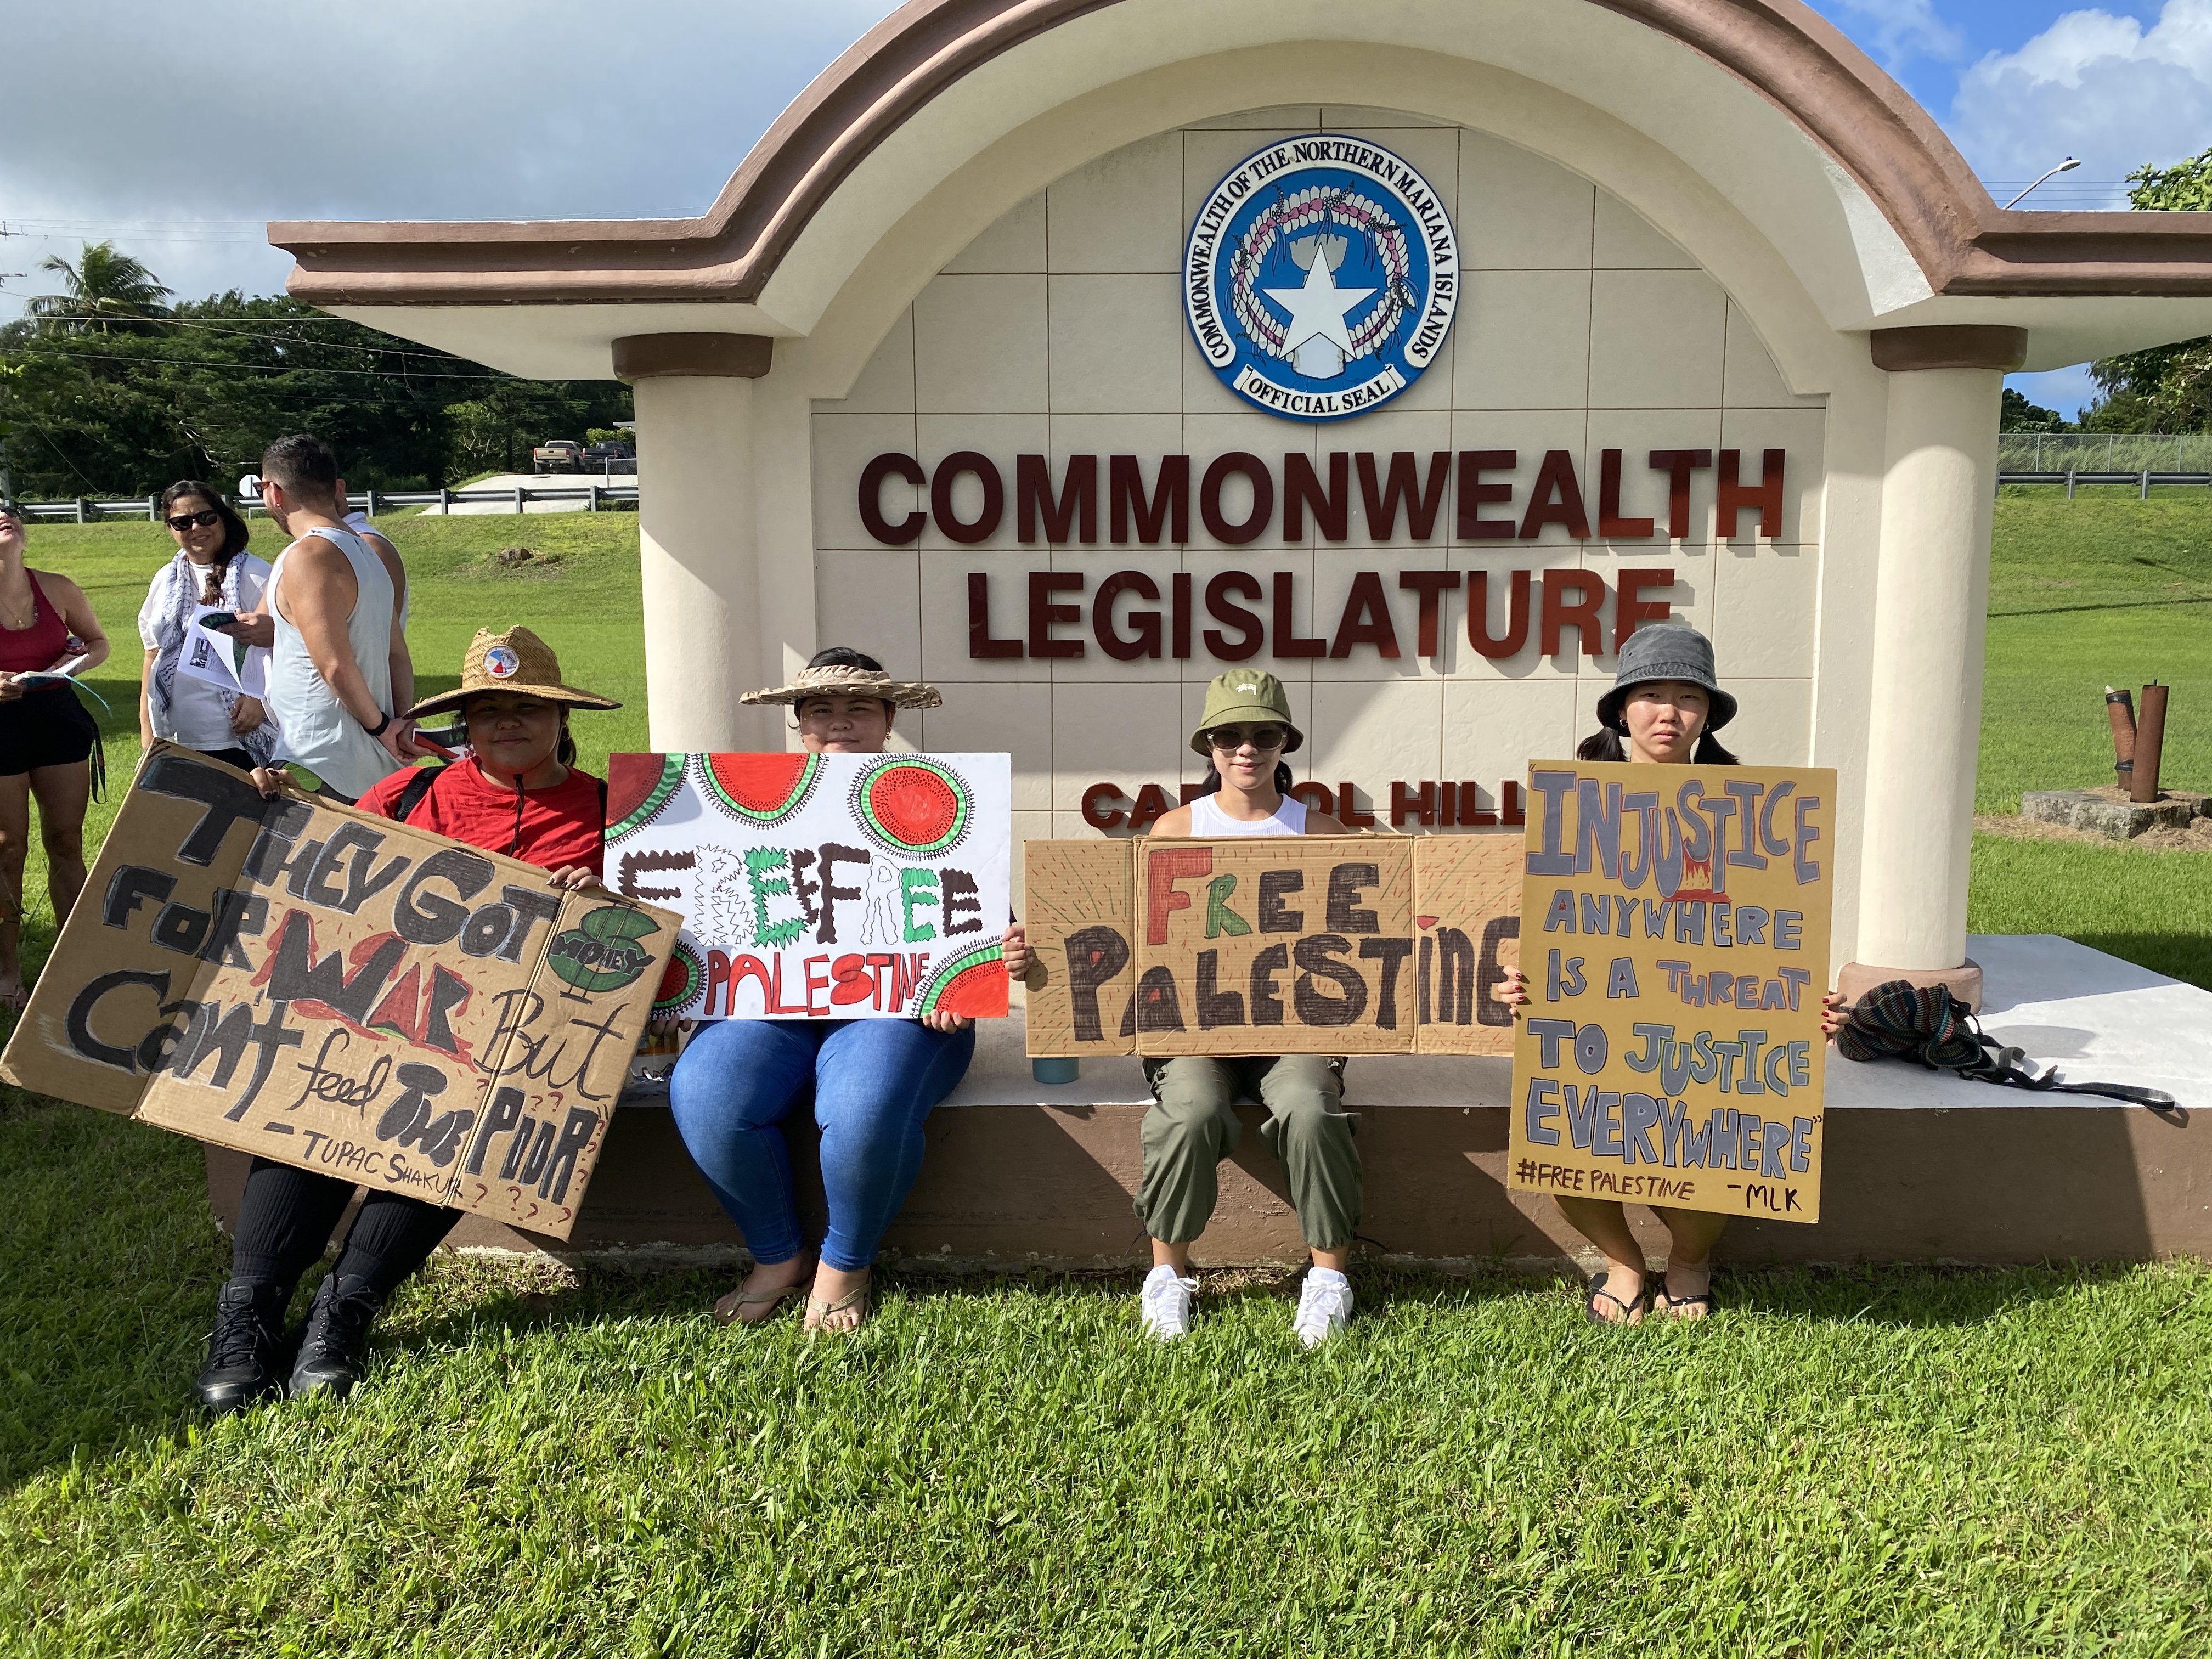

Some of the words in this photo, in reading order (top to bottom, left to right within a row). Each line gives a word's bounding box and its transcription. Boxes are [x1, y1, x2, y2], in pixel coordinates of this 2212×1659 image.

[1227, 173, 1252, 199] OF
[1248, 146, 1293, 181] THE
[1293, 140, 1402, 183] NORTHERN
[1395, 170, 1454, 267] MARIANA
[1190, 191, 1234, 360] COMMONWEALTH
[1413, 272, 1454, 359] ISLANDS
[1248, 377, 1339, 414] OFFICIAL
[1342, 380, 1390, 410] SEAL
[858, 448, 1786, 545] COMMONWEALTH
[967, 568, 1675, 661] LEGISLATURE
[1390, 780, 1526, 826] HILL
[393, 847, 566, 964] GOT
[816, 842, 984, 946] FREE
[1147, 846, 1381, 946] FREE
[1543, 889, 1804, 951] ANYWHERE
[103, 864, 270, 973] FOR
[266, 909, 474, 1056] WAR
[703, 949, 932, 1017] PALESTINE
[1546, 949, 1588, 1002] IS
[1607, 957, 1640, 999] A
[1656, 960, 1811, 1012] THREAT
[285, 1026, 393, 1121] feed
[375, 1060, 475, 1168] THE
[1527, 1018, 1609, 1075] TO
[1624, 1022, 1810, 1097] JUSTICE
